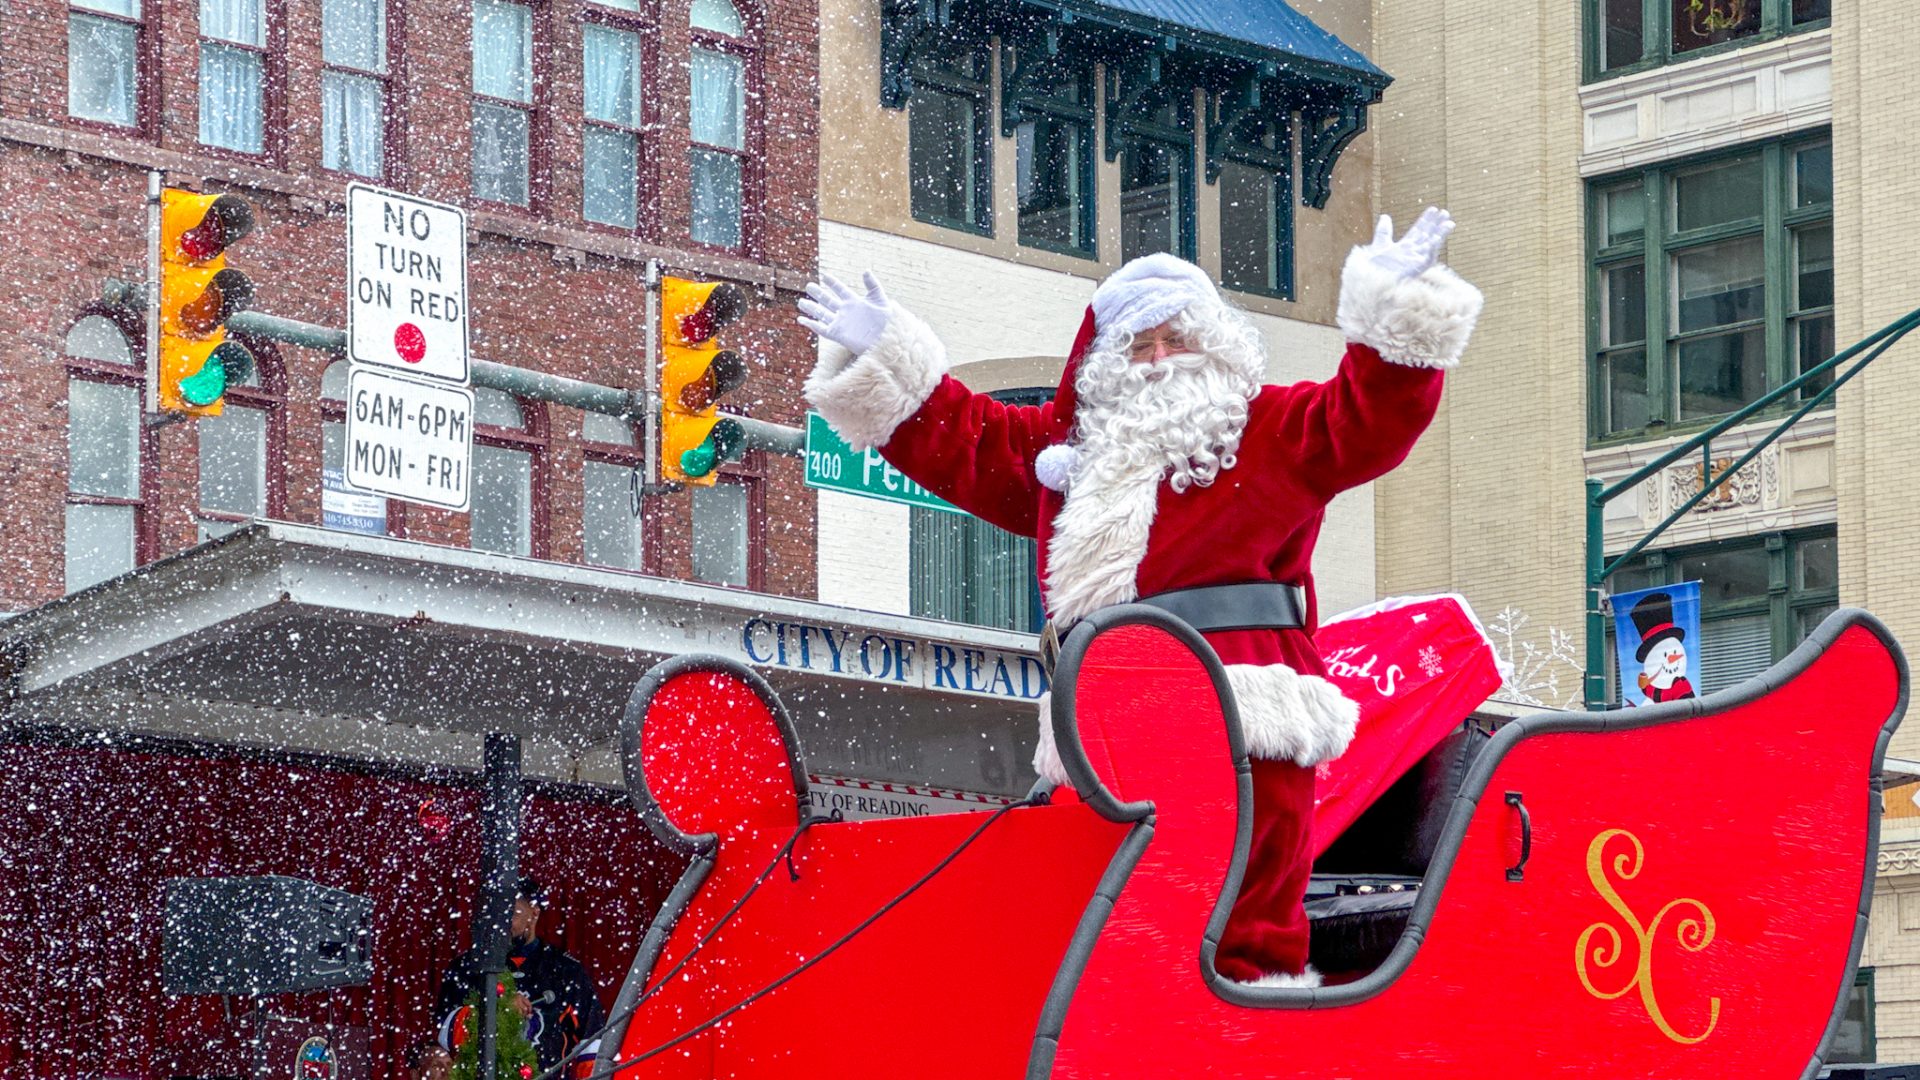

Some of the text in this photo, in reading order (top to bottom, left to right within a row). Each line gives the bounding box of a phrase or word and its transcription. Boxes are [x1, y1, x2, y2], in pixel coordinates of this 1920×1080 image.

[383, 201, 431, 241] NO
[375, 242, 442, 283] TURN
[358, 277, 459, 323] ON RED
[811, 445, 938, 499] 400 Pe
[744, 618, 1050, 699] CITY OF READ
[808, 790, 930, 817] TY OF READING
